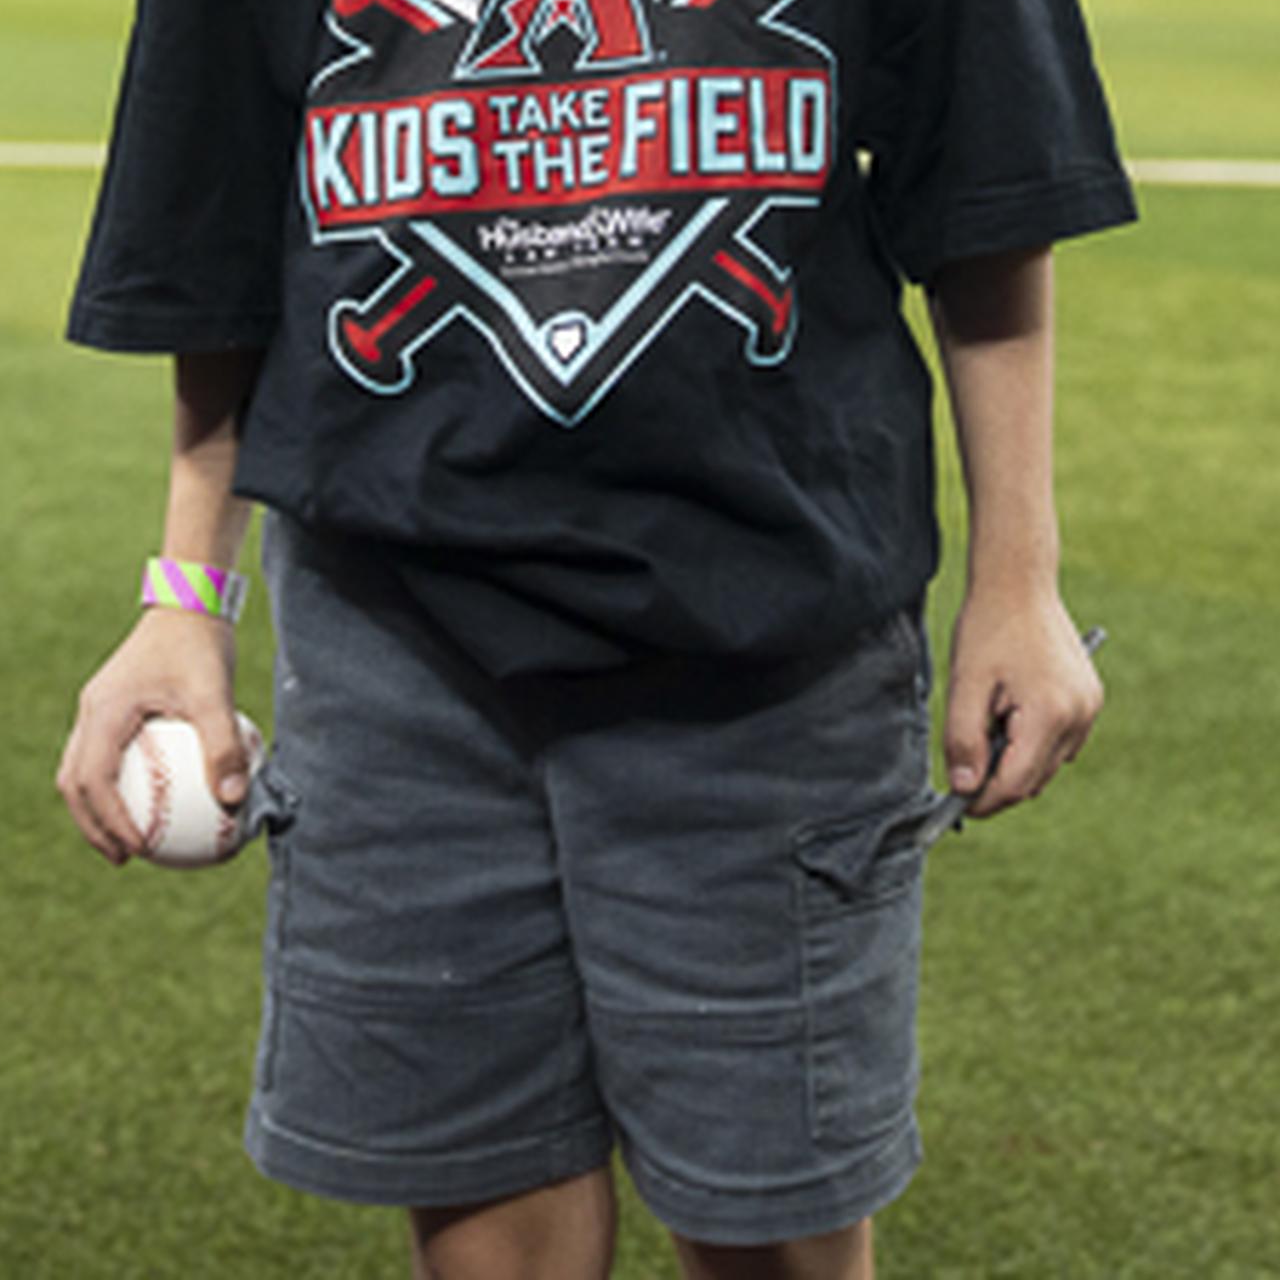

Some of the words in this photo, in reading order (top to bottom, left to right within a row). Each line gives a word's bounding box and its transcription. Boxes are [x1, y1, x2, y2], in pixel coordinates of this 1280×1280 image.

[489, 89, 610, 133] TAKE
[620, 77, 827, 179] FIELD
[311, 98, 479, 208] KIDS
[492, 132, 611, 192] THE
